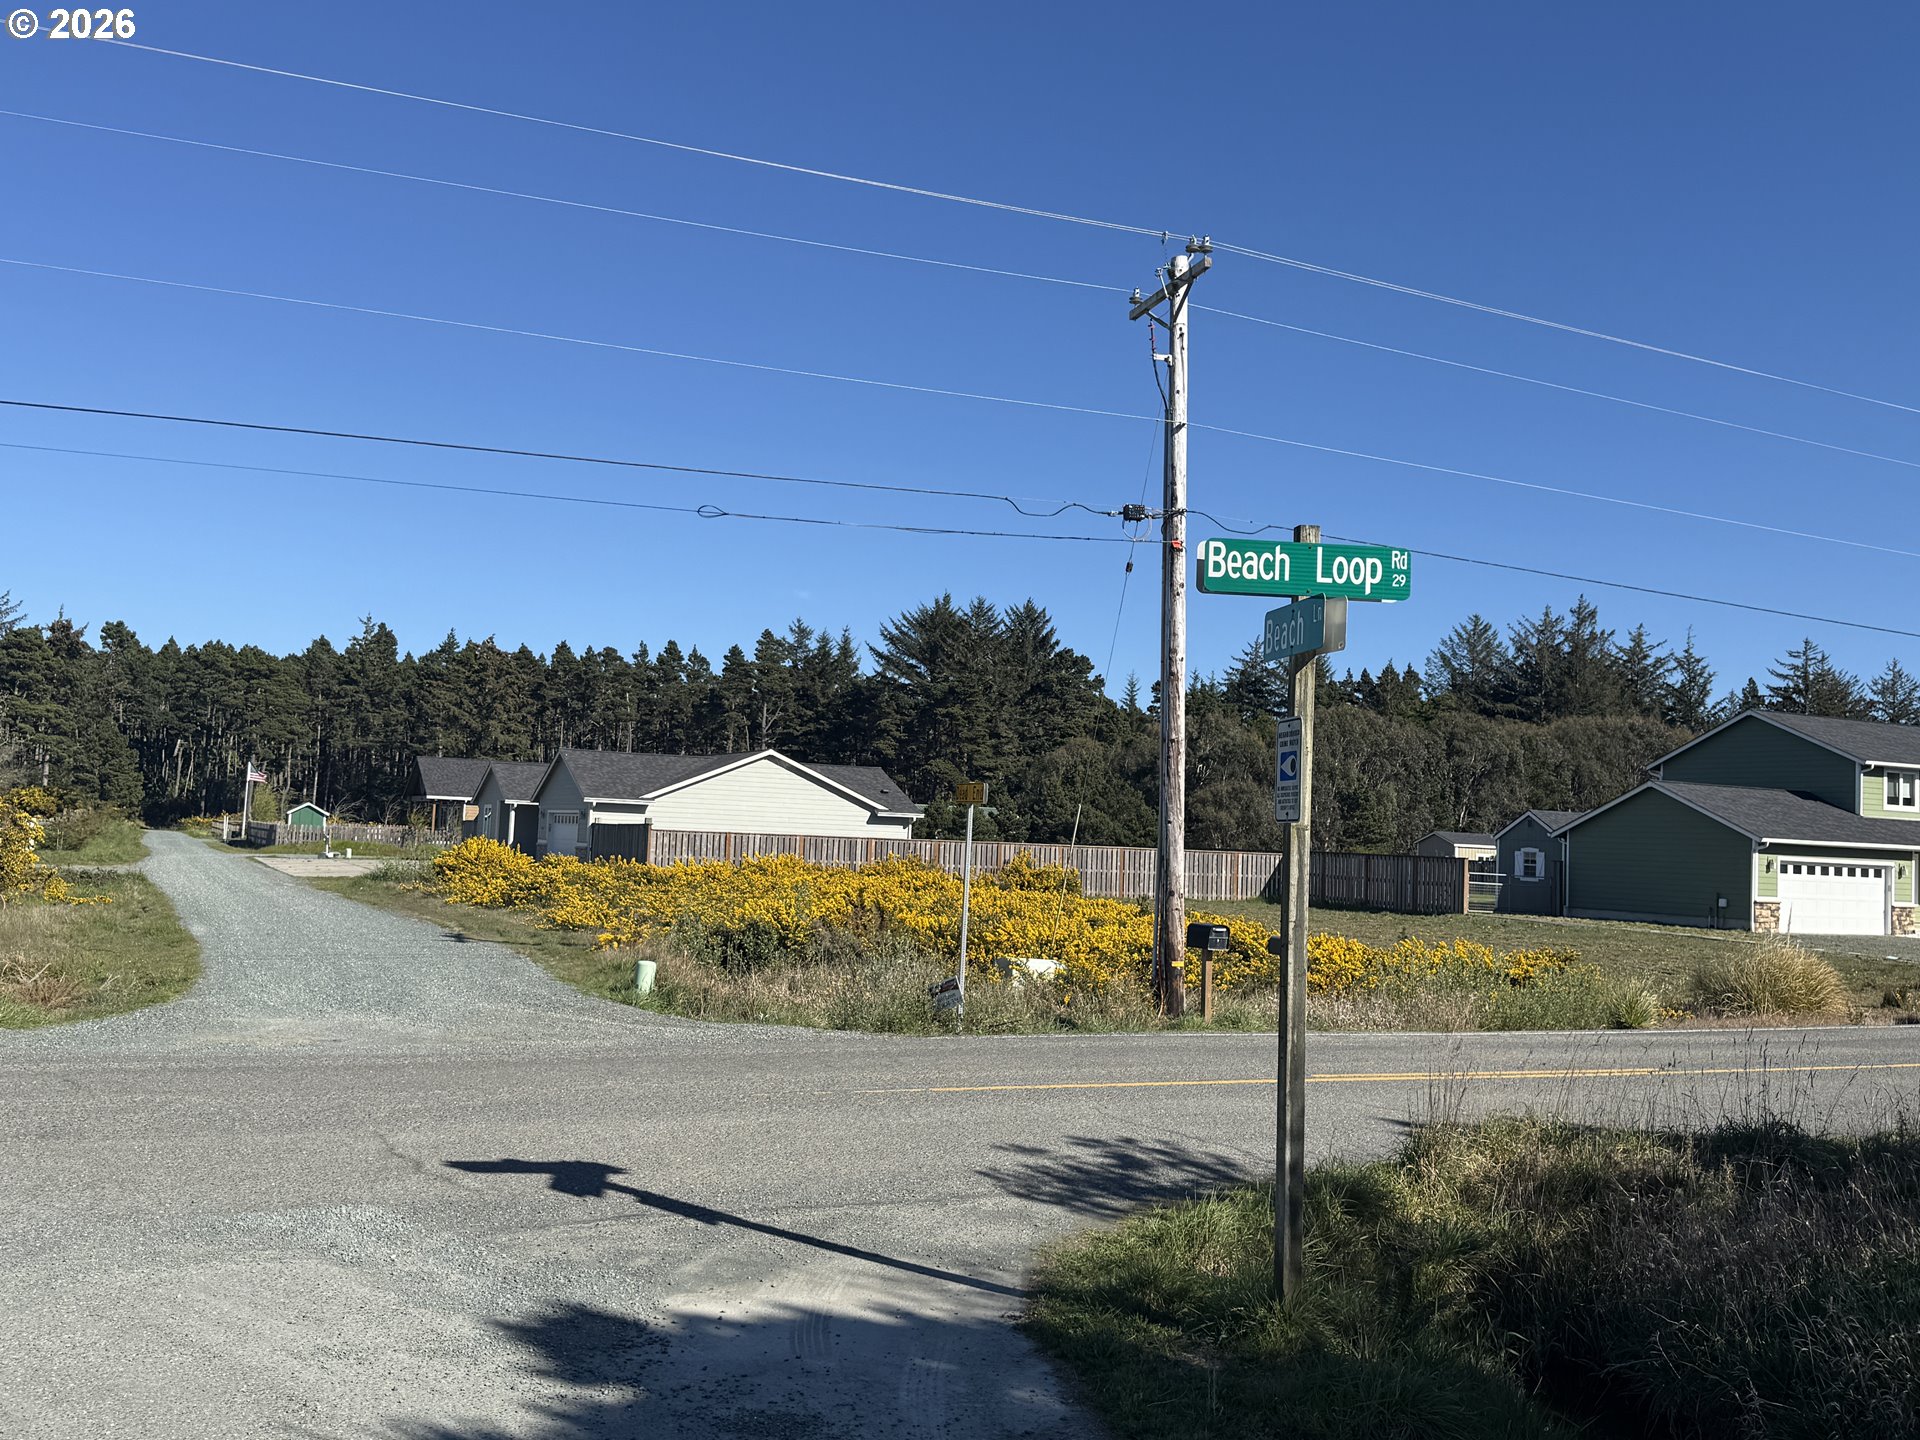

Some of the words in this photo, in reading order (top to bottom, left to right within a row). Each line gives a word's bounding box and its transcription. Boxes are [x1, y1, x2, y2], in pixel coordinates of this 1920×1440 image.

[1207, 541, 1290, 581] Beach
[1316, 546, 1383, 595] Loop
[1391, 550, 1408, 570] Rd
[1392, 574, 1407, 587] 29
[1265, 610, 1304, 654] Beach
[1313, 604, 1321, 622] Ln
